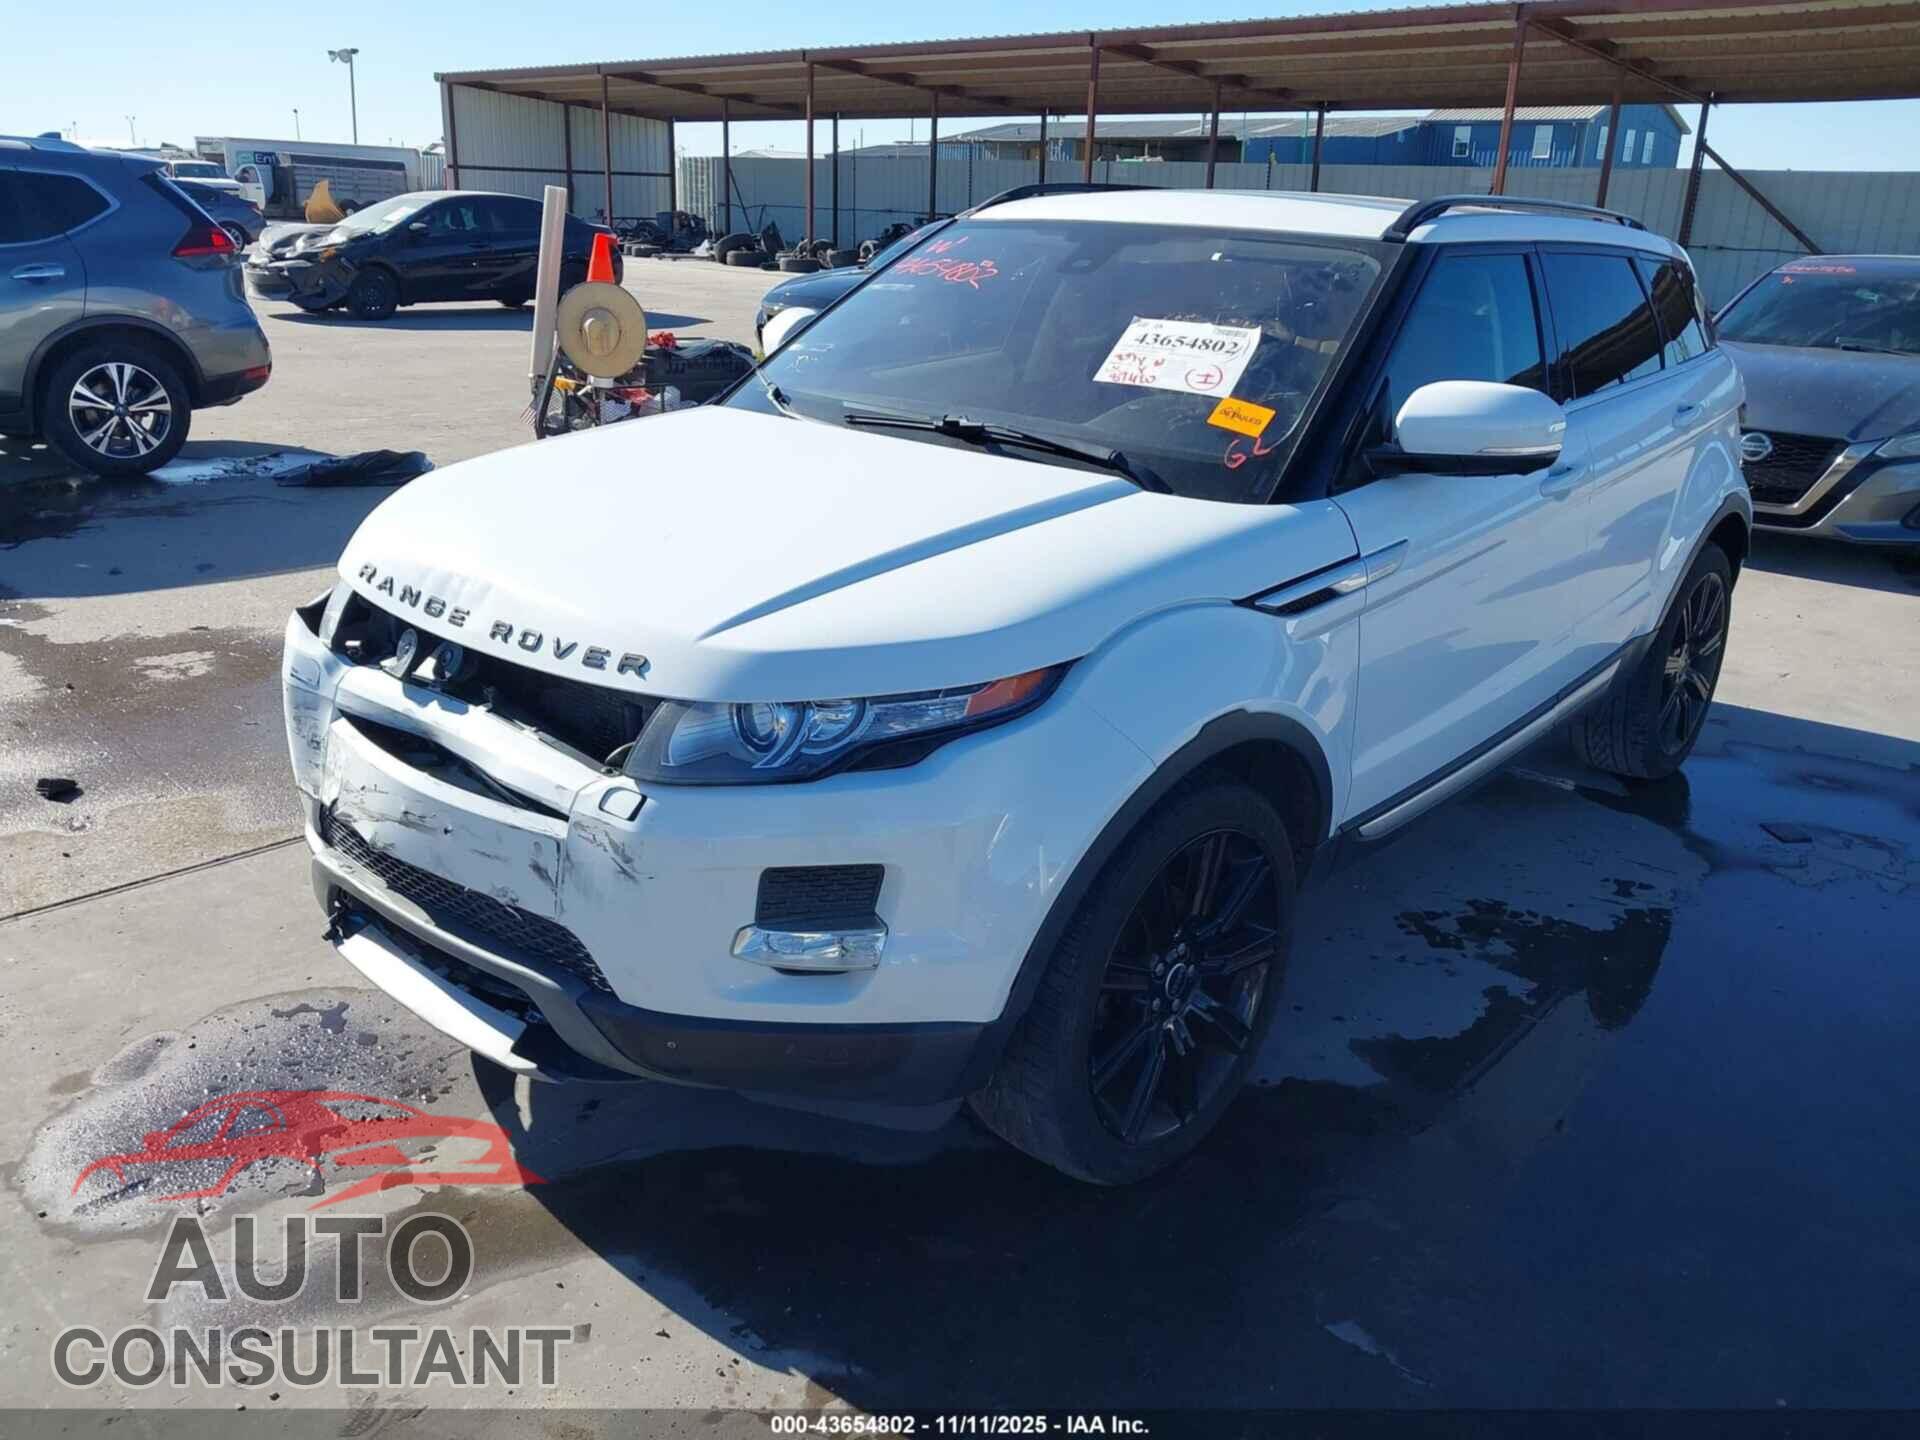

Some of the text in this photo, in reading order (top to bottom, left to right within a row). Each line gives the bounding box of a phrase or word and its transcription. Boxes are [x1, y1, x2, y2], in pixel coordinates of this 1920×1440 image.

[1133, 332, 1240, 356] 43654802
[357, 562, 652, 682] RANGE ROVER
